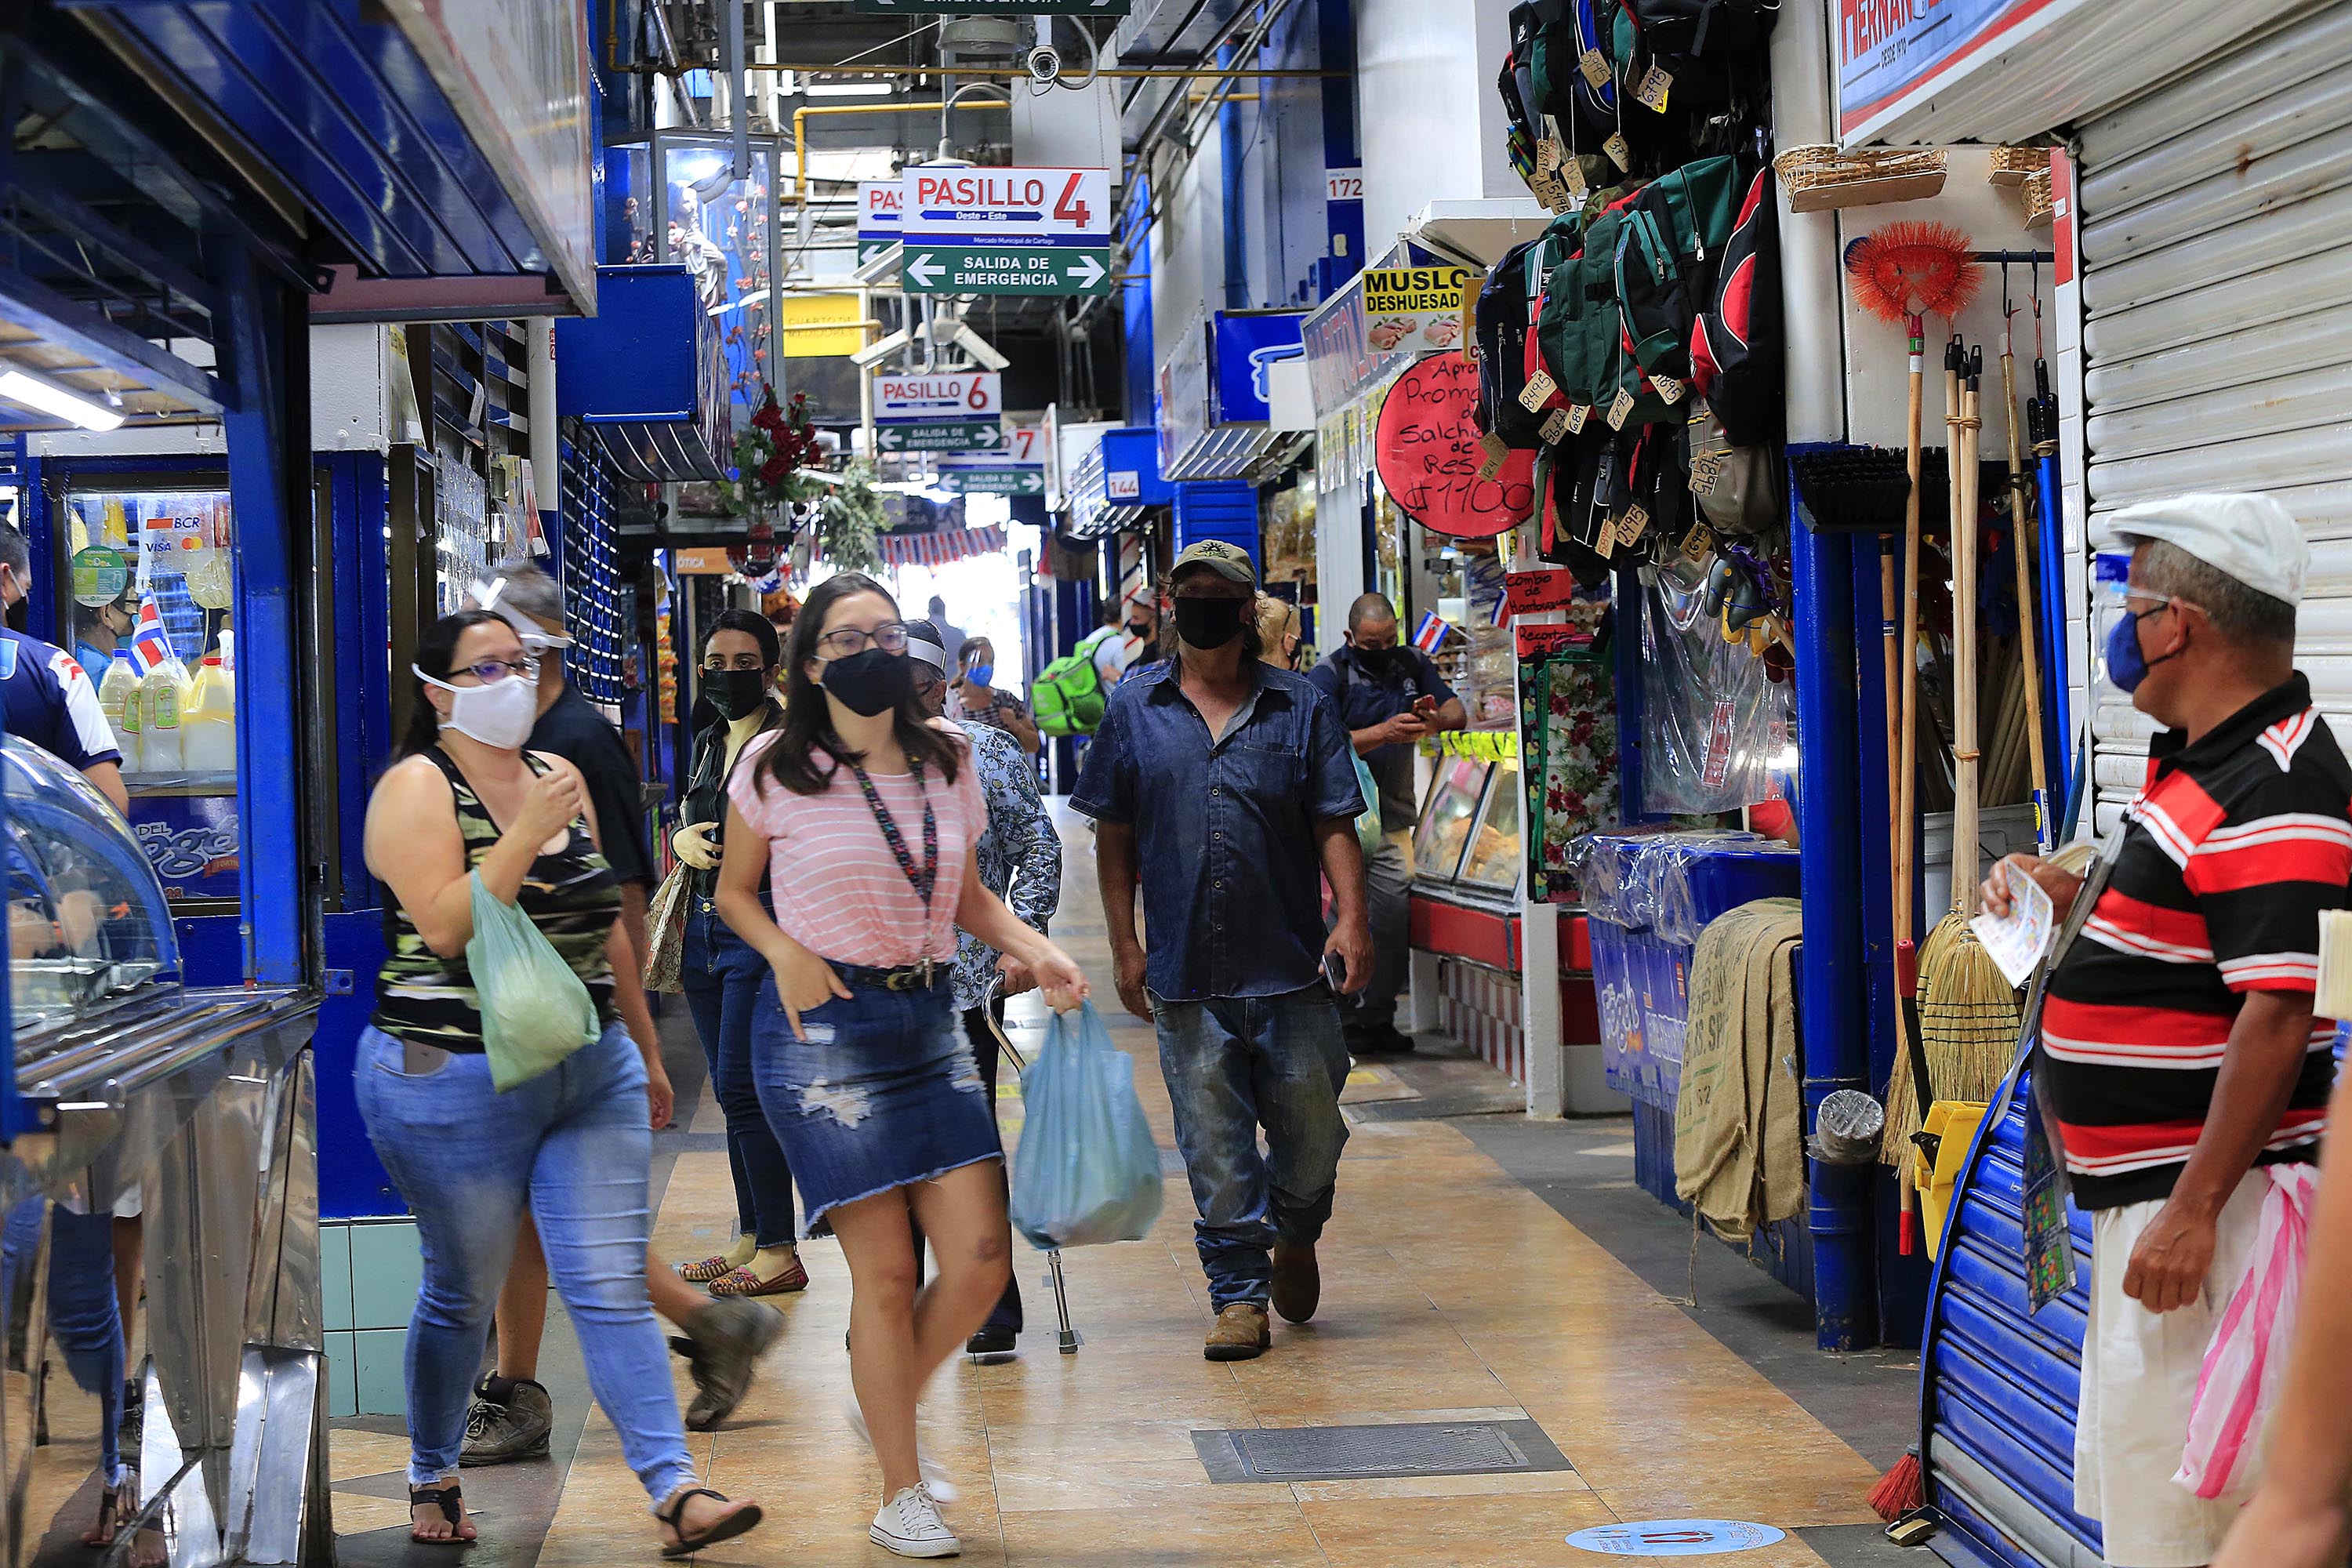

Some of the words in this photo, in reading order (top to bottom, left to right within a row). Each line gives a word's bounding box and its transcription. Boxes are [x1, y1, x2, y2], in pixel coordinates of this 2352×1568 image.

[1882, 43, 1896, 70] DESDE
[1642, 72, 1667, 103] 6.795
[1329, 179, 1363, 197] 172
[918, 178, 1044, 206] PASILLO
[1053, 172, 1091, 228] 4
[956, 211, 981, 220] Oeste
[988, 212, 1007, 220] Este
[998, 238, 1024, 246] Municipal
[1033, 238, 1055, 246] Cartago
[964, 256, 1022, 270] SALIDA
[1029, 257, 1050, 270] DE
[953, 273, 1058, 286] EMERGENCIA
[1365, 269, 1471, 293] MUSLO
[1367, 292, 1464, 312] DESHUESAD
[884, 382, 961, 400] PASILLO
[967, 376, 989, 410] 6
[1523, 376, 1552, 409] 8.495
[912, 427, 949, 437] SALIDA
[951, 427, 965, 436] DE
[906, 437, 971, 448] EMERGENCIA
[1016, 431, 1035, 459] 7
[1450, 441, 1474, 454] de
[1423, 455, 1476, 475] Res
[1110, 480, 1136, 495] 144
[174, 517, 201, 528] BCR
[145, 543, 172, 553] VISA
[1506, 572, 1552, 587] Combo
[1524, 586, 1541, 597] de
[139, 825, 170, 836] DEL
